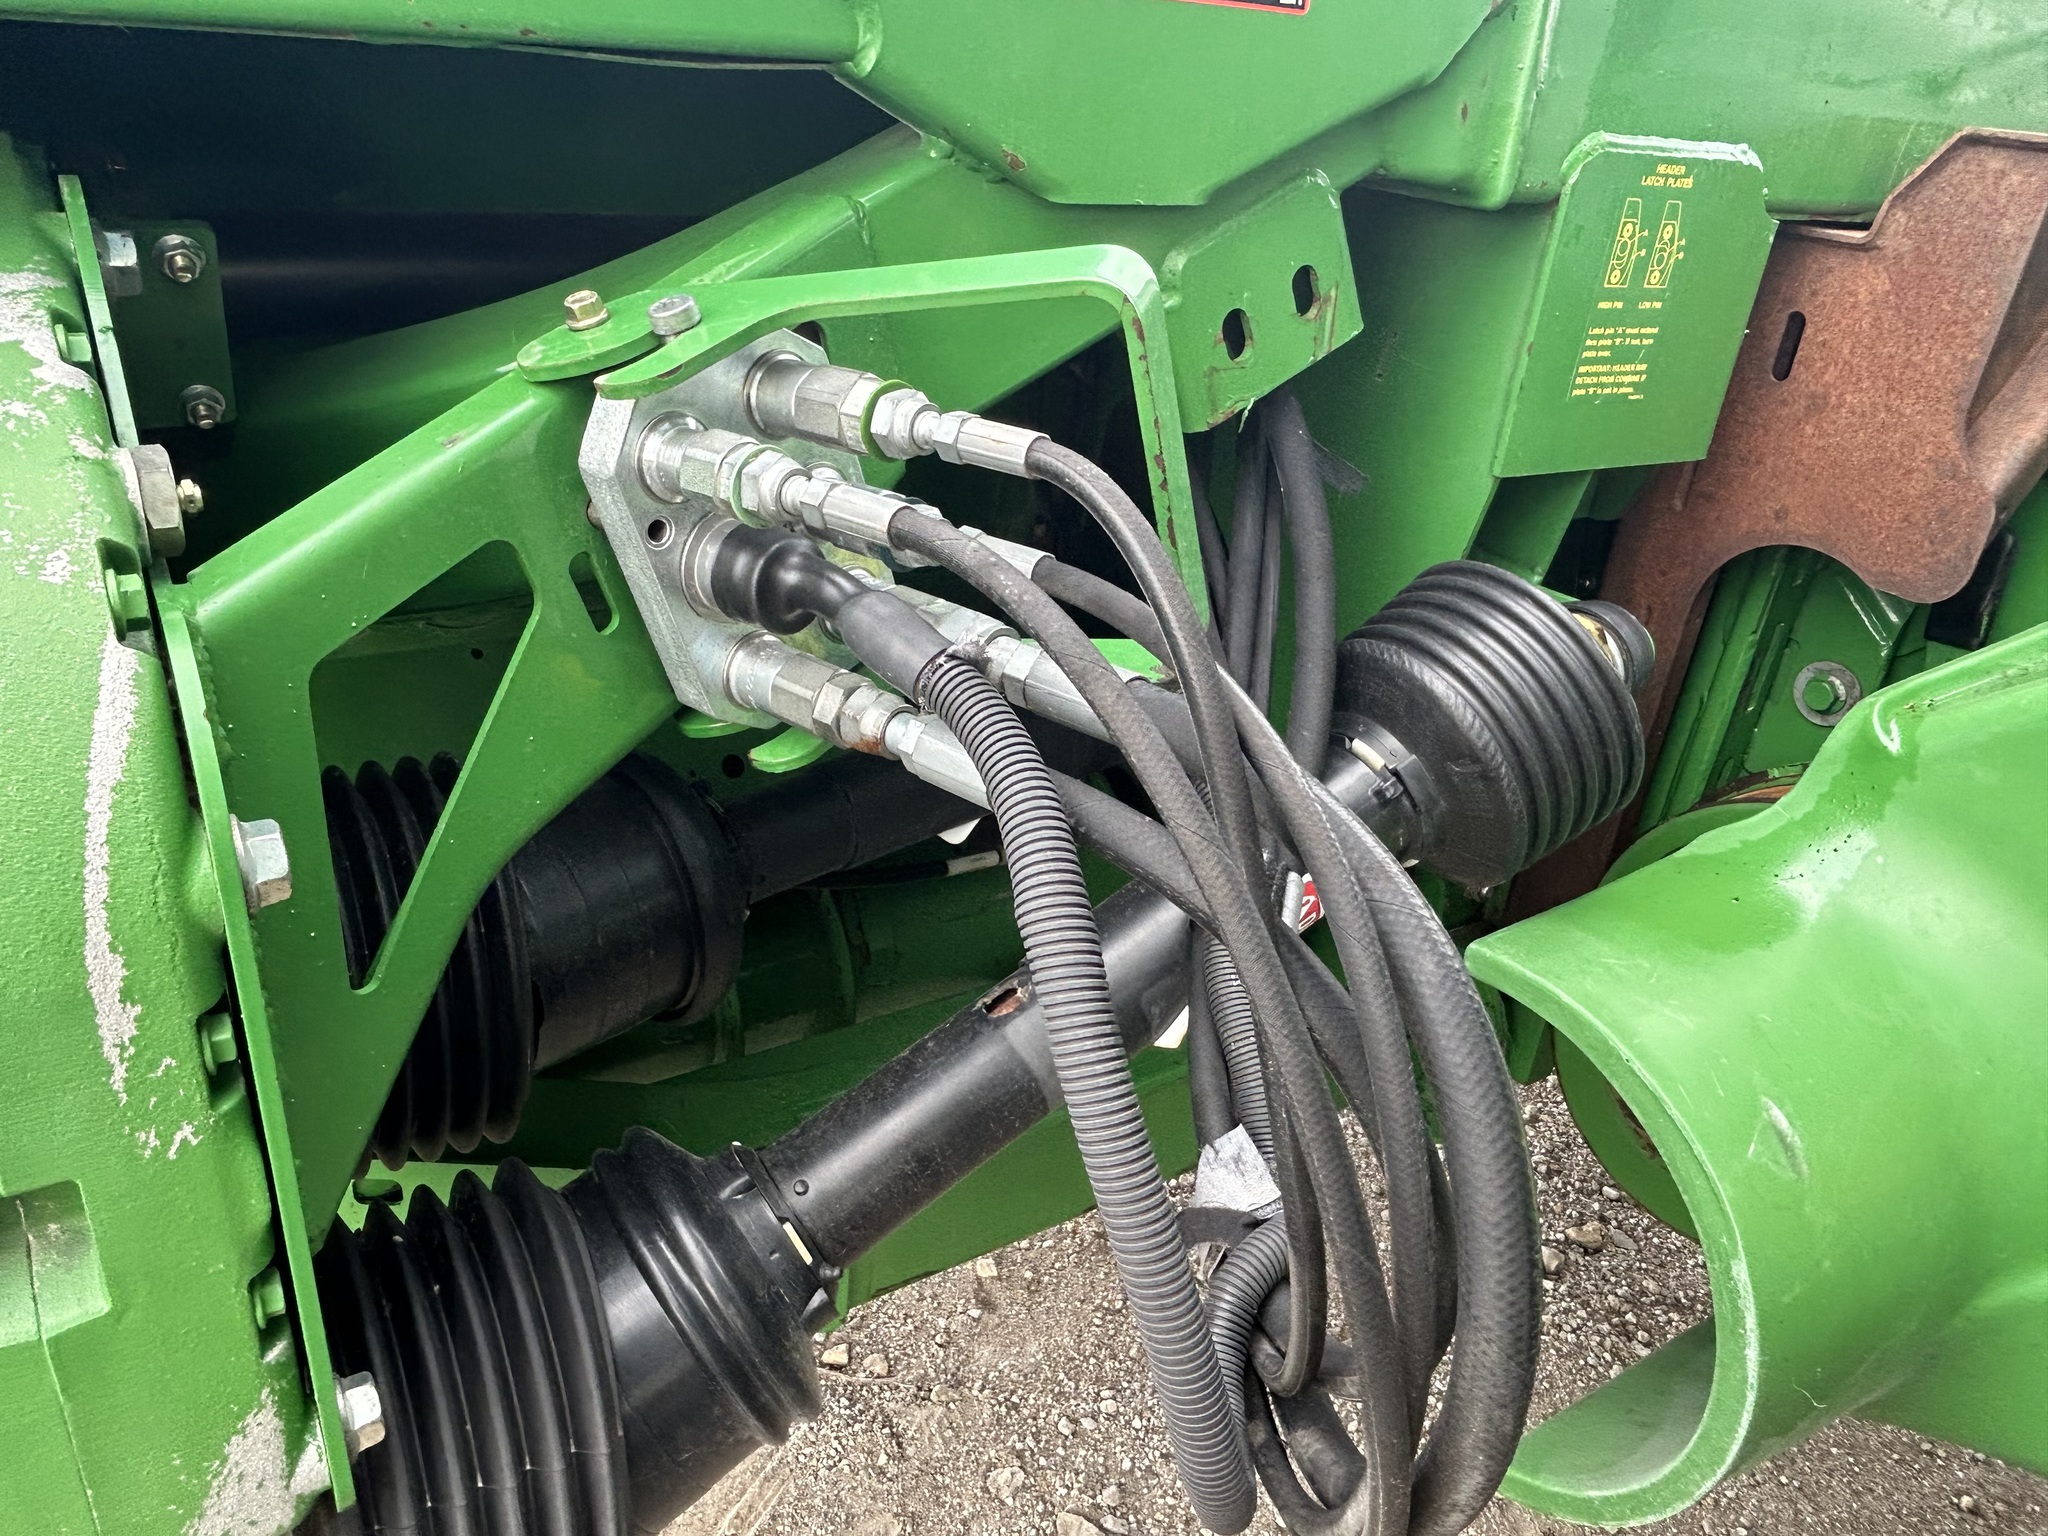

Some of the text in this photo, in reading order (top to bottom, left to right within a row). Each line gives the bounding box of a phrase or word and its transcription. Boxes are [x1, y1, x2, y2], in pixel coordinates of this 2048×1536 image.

[1656, 164, 1686, 175] HEADER
[1641, 175, 1693, 188] LATCH PLATES
[1597, 301, 1624, 309] HIGH PIN
[1638, 301, 1663, 309] LOW PIN
[1604, 327, 1615, 335] pin
[1578, 365, 1611, 373] IMPORTANT:
[1612, 364, 1635, 372] HEADER
[1575, 376, 1598, 384] DETACH
[1599, 375, 1615, 383] FROM
[1572, 388, 1586, 397] plate
